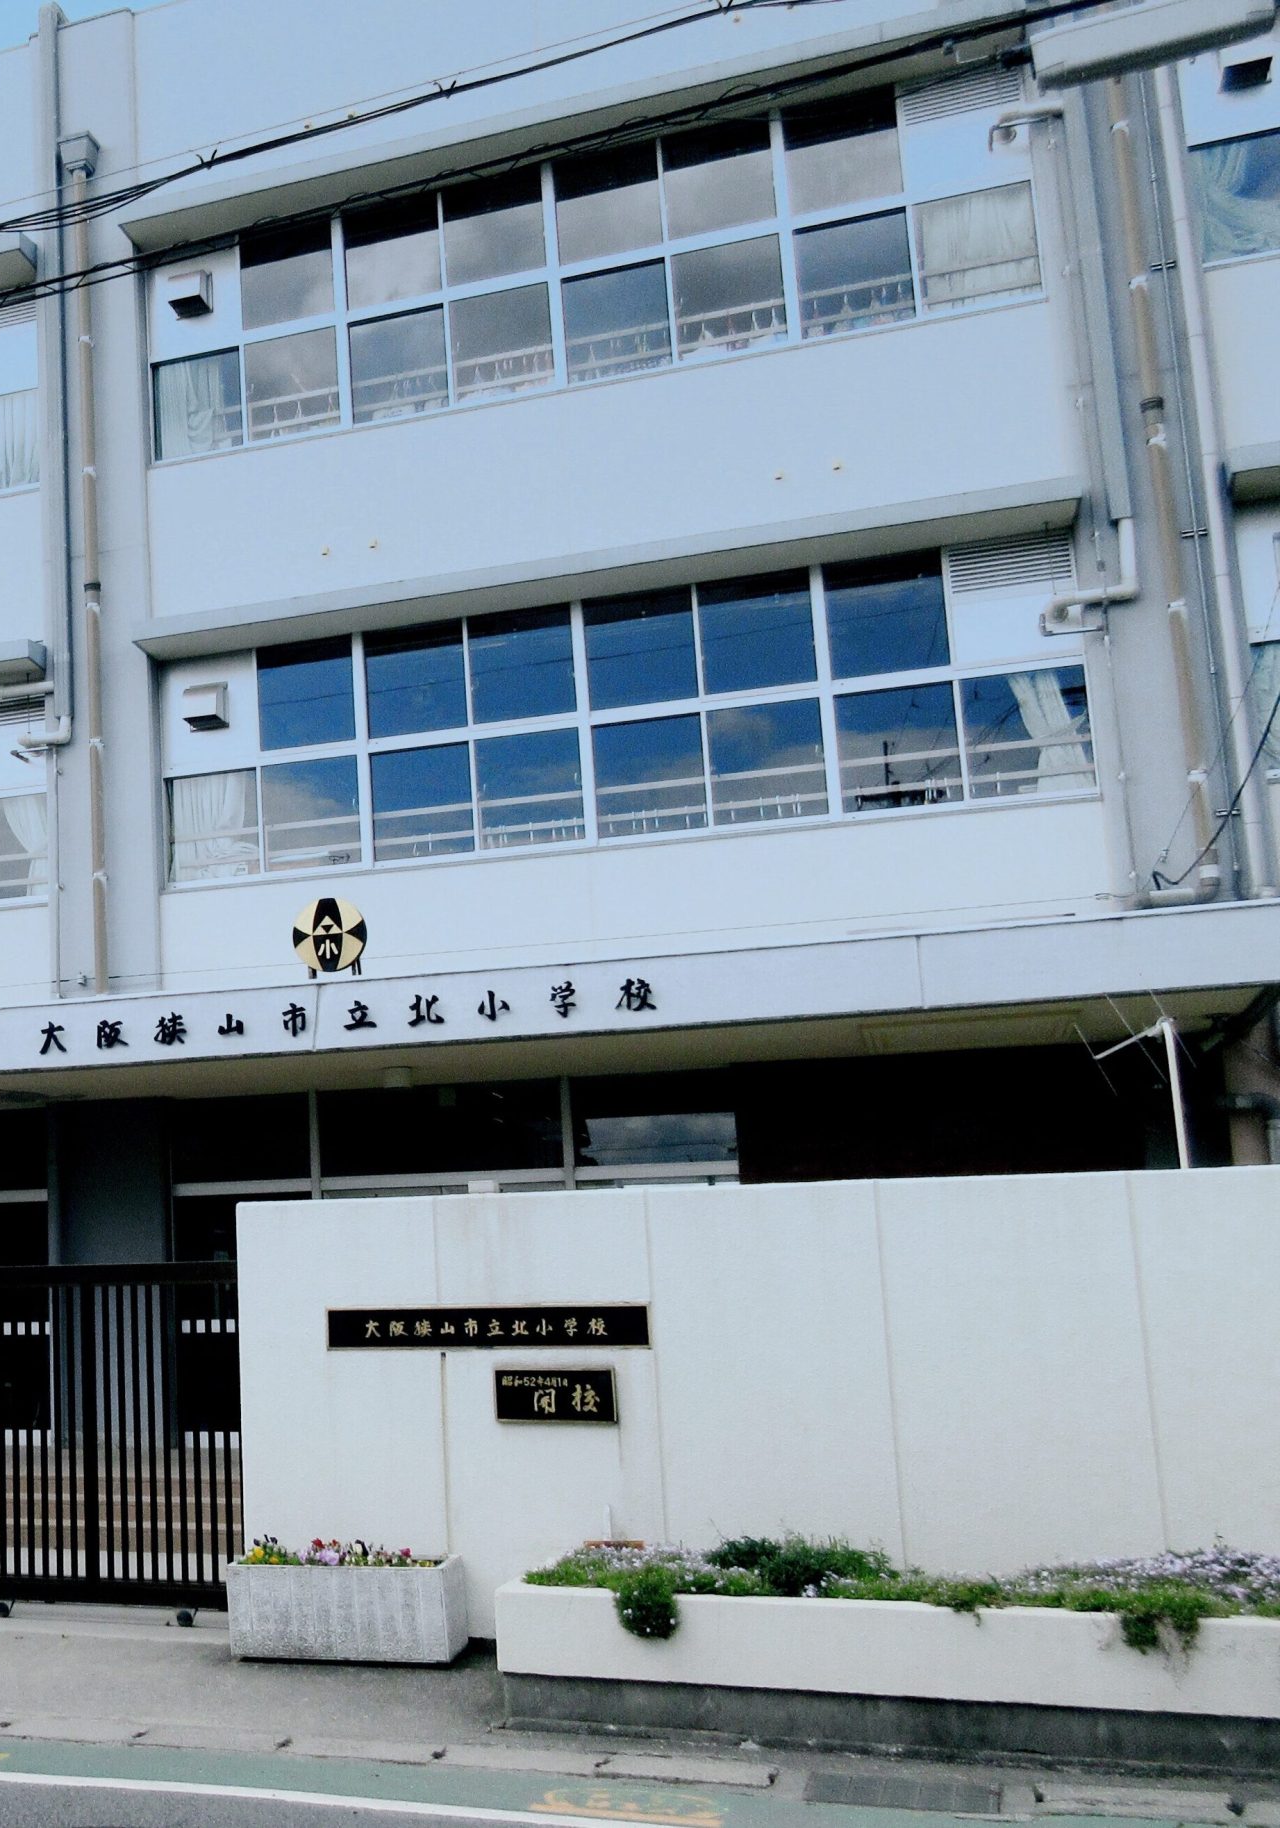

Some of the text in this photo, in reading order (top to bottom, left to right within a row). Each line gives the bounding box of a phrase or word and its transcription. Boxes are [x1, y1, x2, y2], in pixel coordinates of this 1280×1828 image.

[38, 976, 658, 1056] 大阪狭山市立北小学校
[364, 1317, 609, 1338] 大阪狭山市立北小学校
[533, 1383, 601, 1414] 開校
